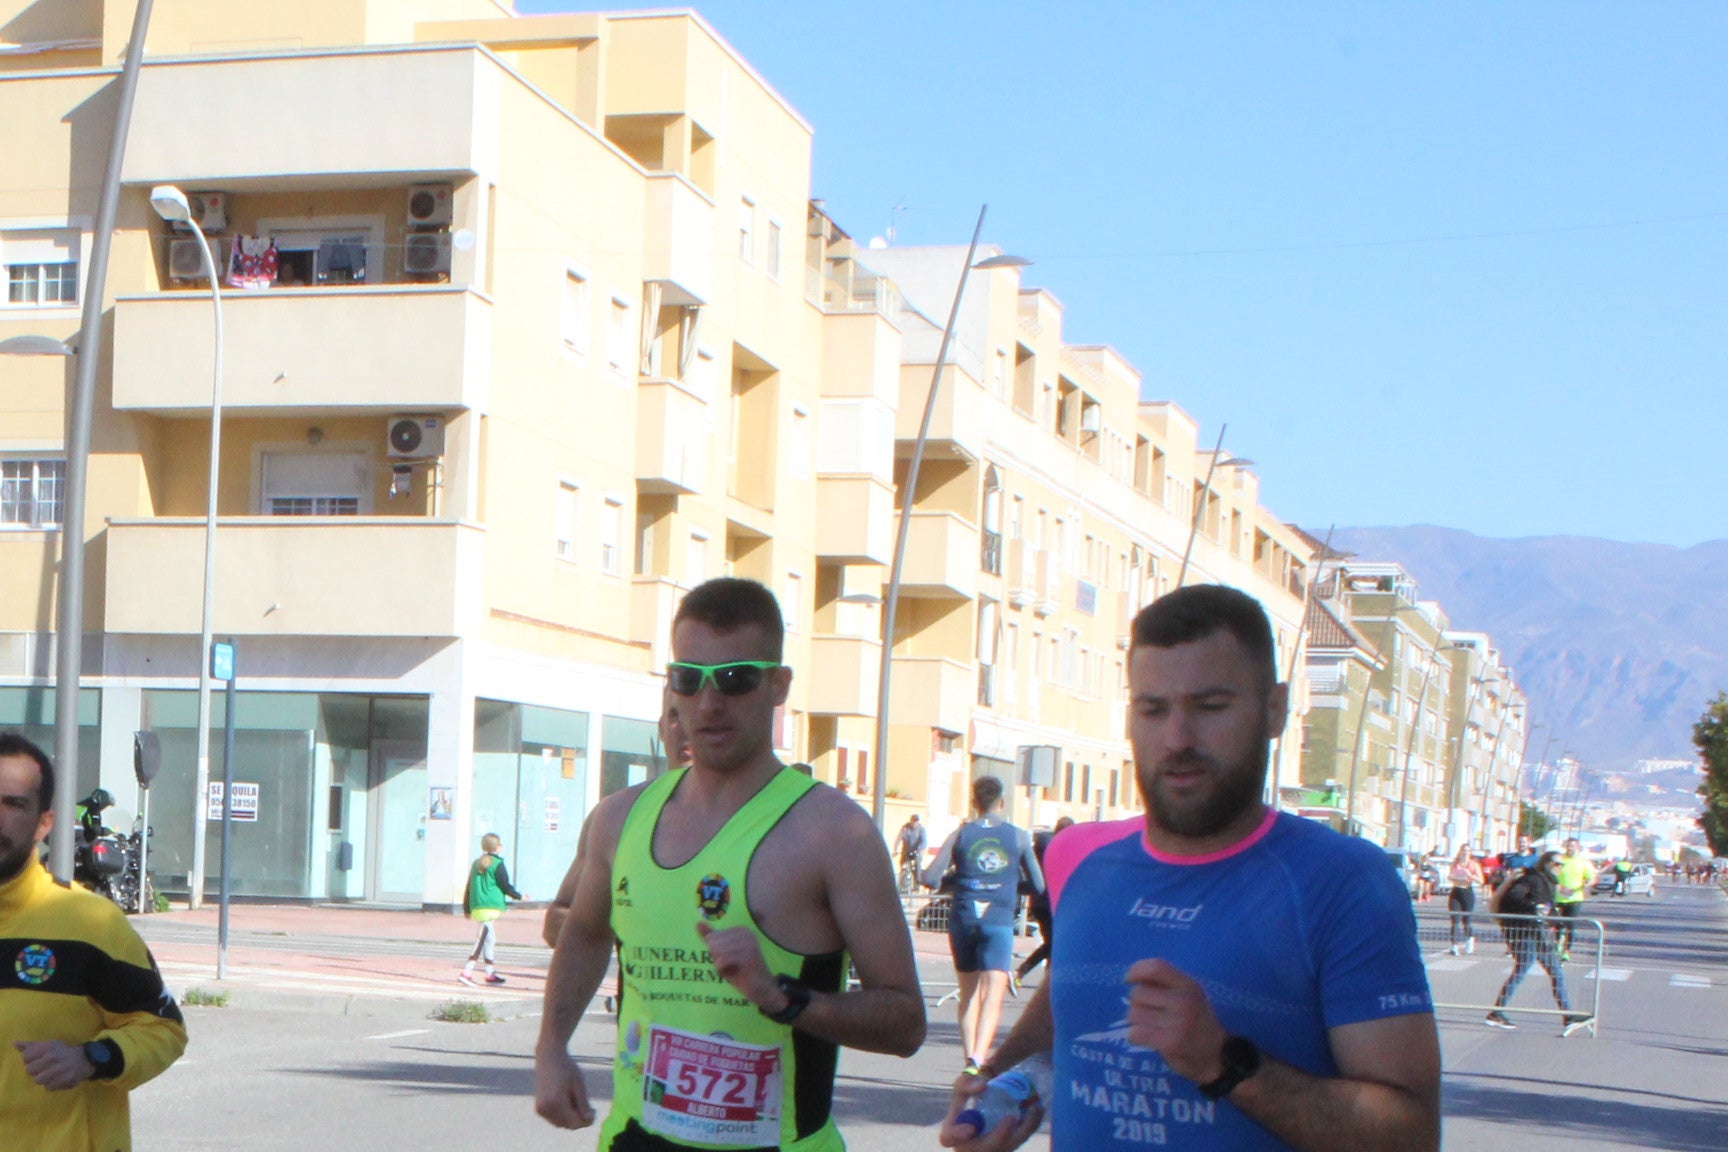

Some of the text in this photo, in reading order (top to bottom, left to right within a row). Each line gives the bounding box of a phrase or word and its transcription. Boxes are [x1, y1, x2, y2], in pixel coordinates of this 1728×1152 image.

[1128, 897, 1203, 922] land
[676, 1063, 748, 1105] 572
[1072, 1080, 1215, 1125] MARATON
[1113, 1116, 1167, 1145] 2019
